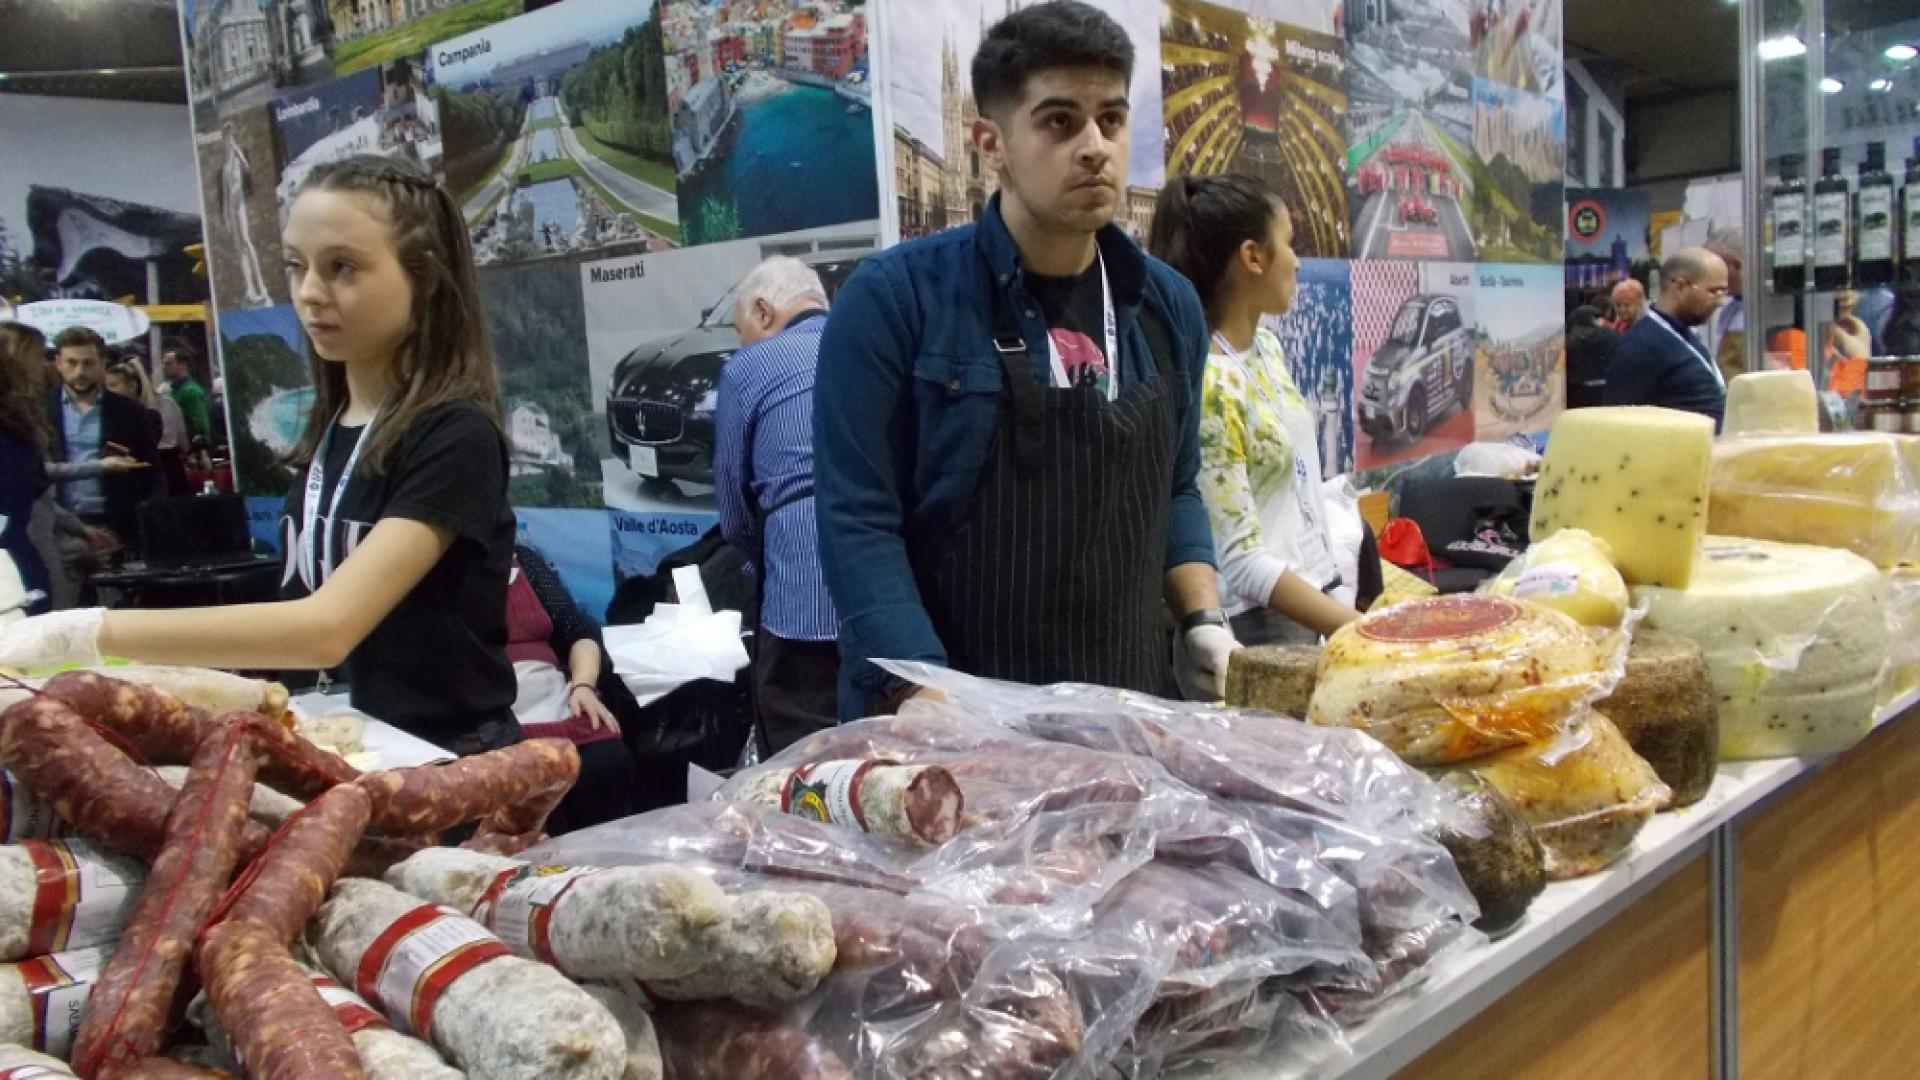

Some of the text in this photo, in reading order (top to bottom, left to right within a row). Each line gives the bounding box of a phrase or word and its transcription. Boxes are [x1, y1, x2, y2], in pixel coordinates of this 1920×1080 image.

[438, 37, 492, 67] Campania
[590, 260, 645, 283] Maserati
[614, 516, 698, 536] Valle d'Aosta
